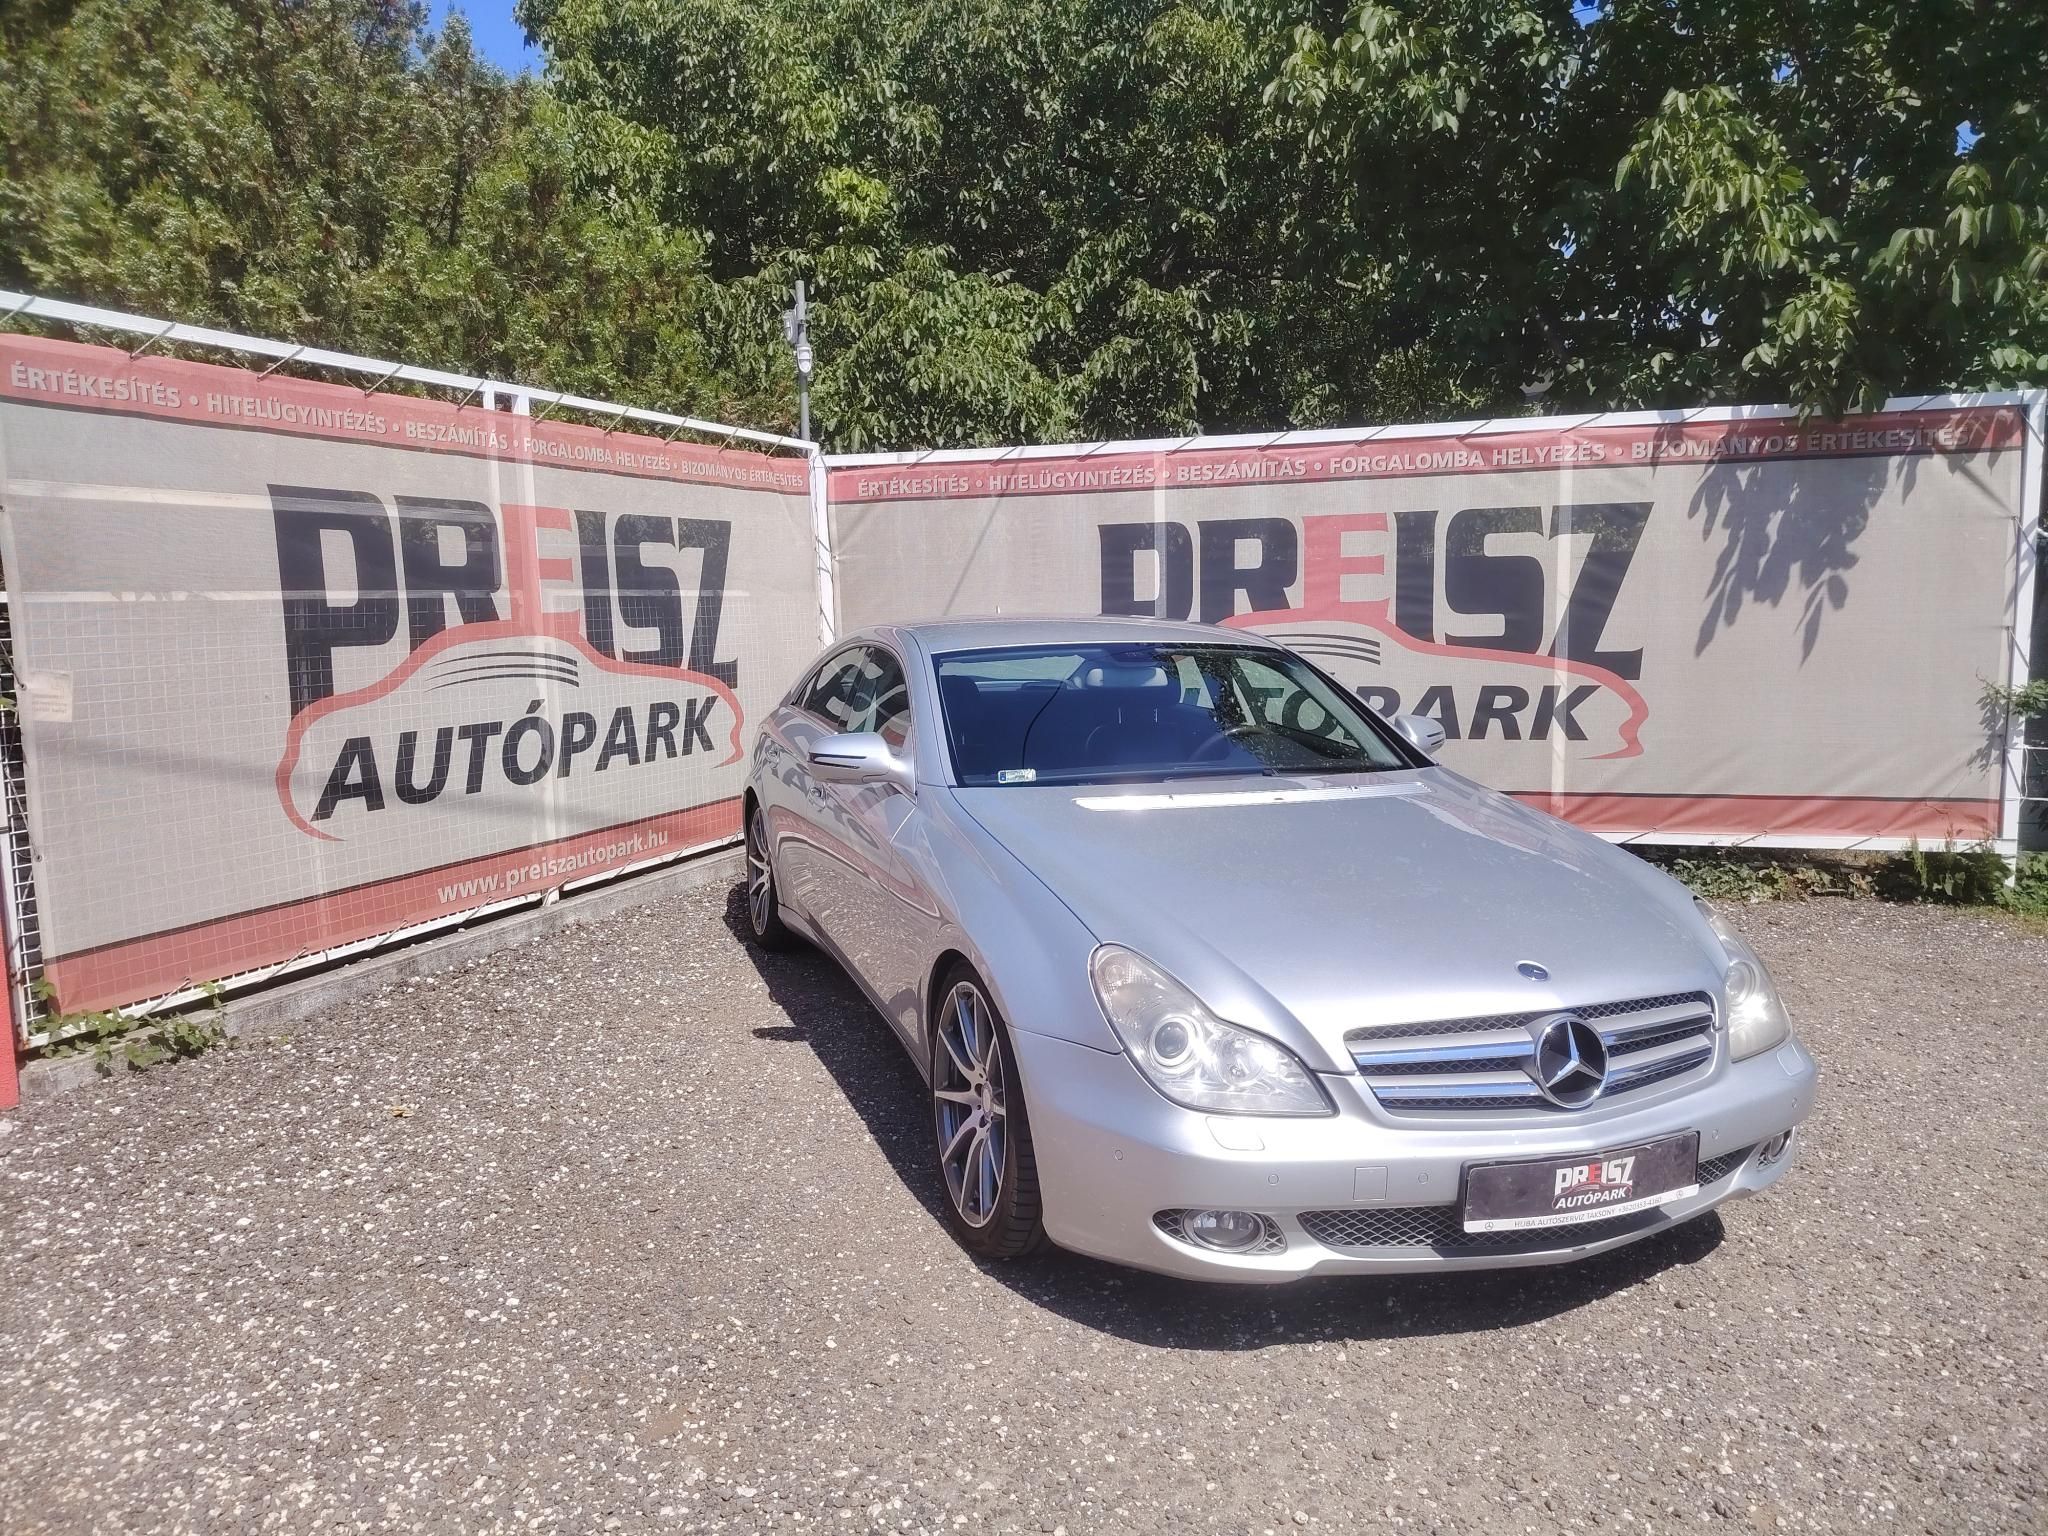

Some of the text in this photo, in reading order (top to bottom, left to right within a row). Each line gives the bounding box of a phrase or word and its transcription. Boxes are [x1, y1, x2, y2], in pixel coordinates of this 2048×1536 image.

[10, 361, 803, 488] ÉRTÉKESÍTÉS HITELÜGYINTÉZÉS BESZÁMÍTÁS FORGALOMBA HELYEZÉS BIZOMÁNYOS ÉRTÉKESÍTÉS
[858, 419, 1971, 497] ÉRTÉKESÍTÉS HITELÜGYINTÉZÉS BESZÁMÍTÁS FORGALOMBA HELYEZÉS BIZOMÁNYOS ÉRTÉKESÍTÉS
[266, 483, 739, 721] PREISZ
[309, 696, 719, 822] AUTÓPARK
[436, 829, 669, 905] www.preiszautopark.hu
[1554, 1156, 1636, 1196] PREISZ
[1555, 1187, 1628, 1209] AUTÓPARK
